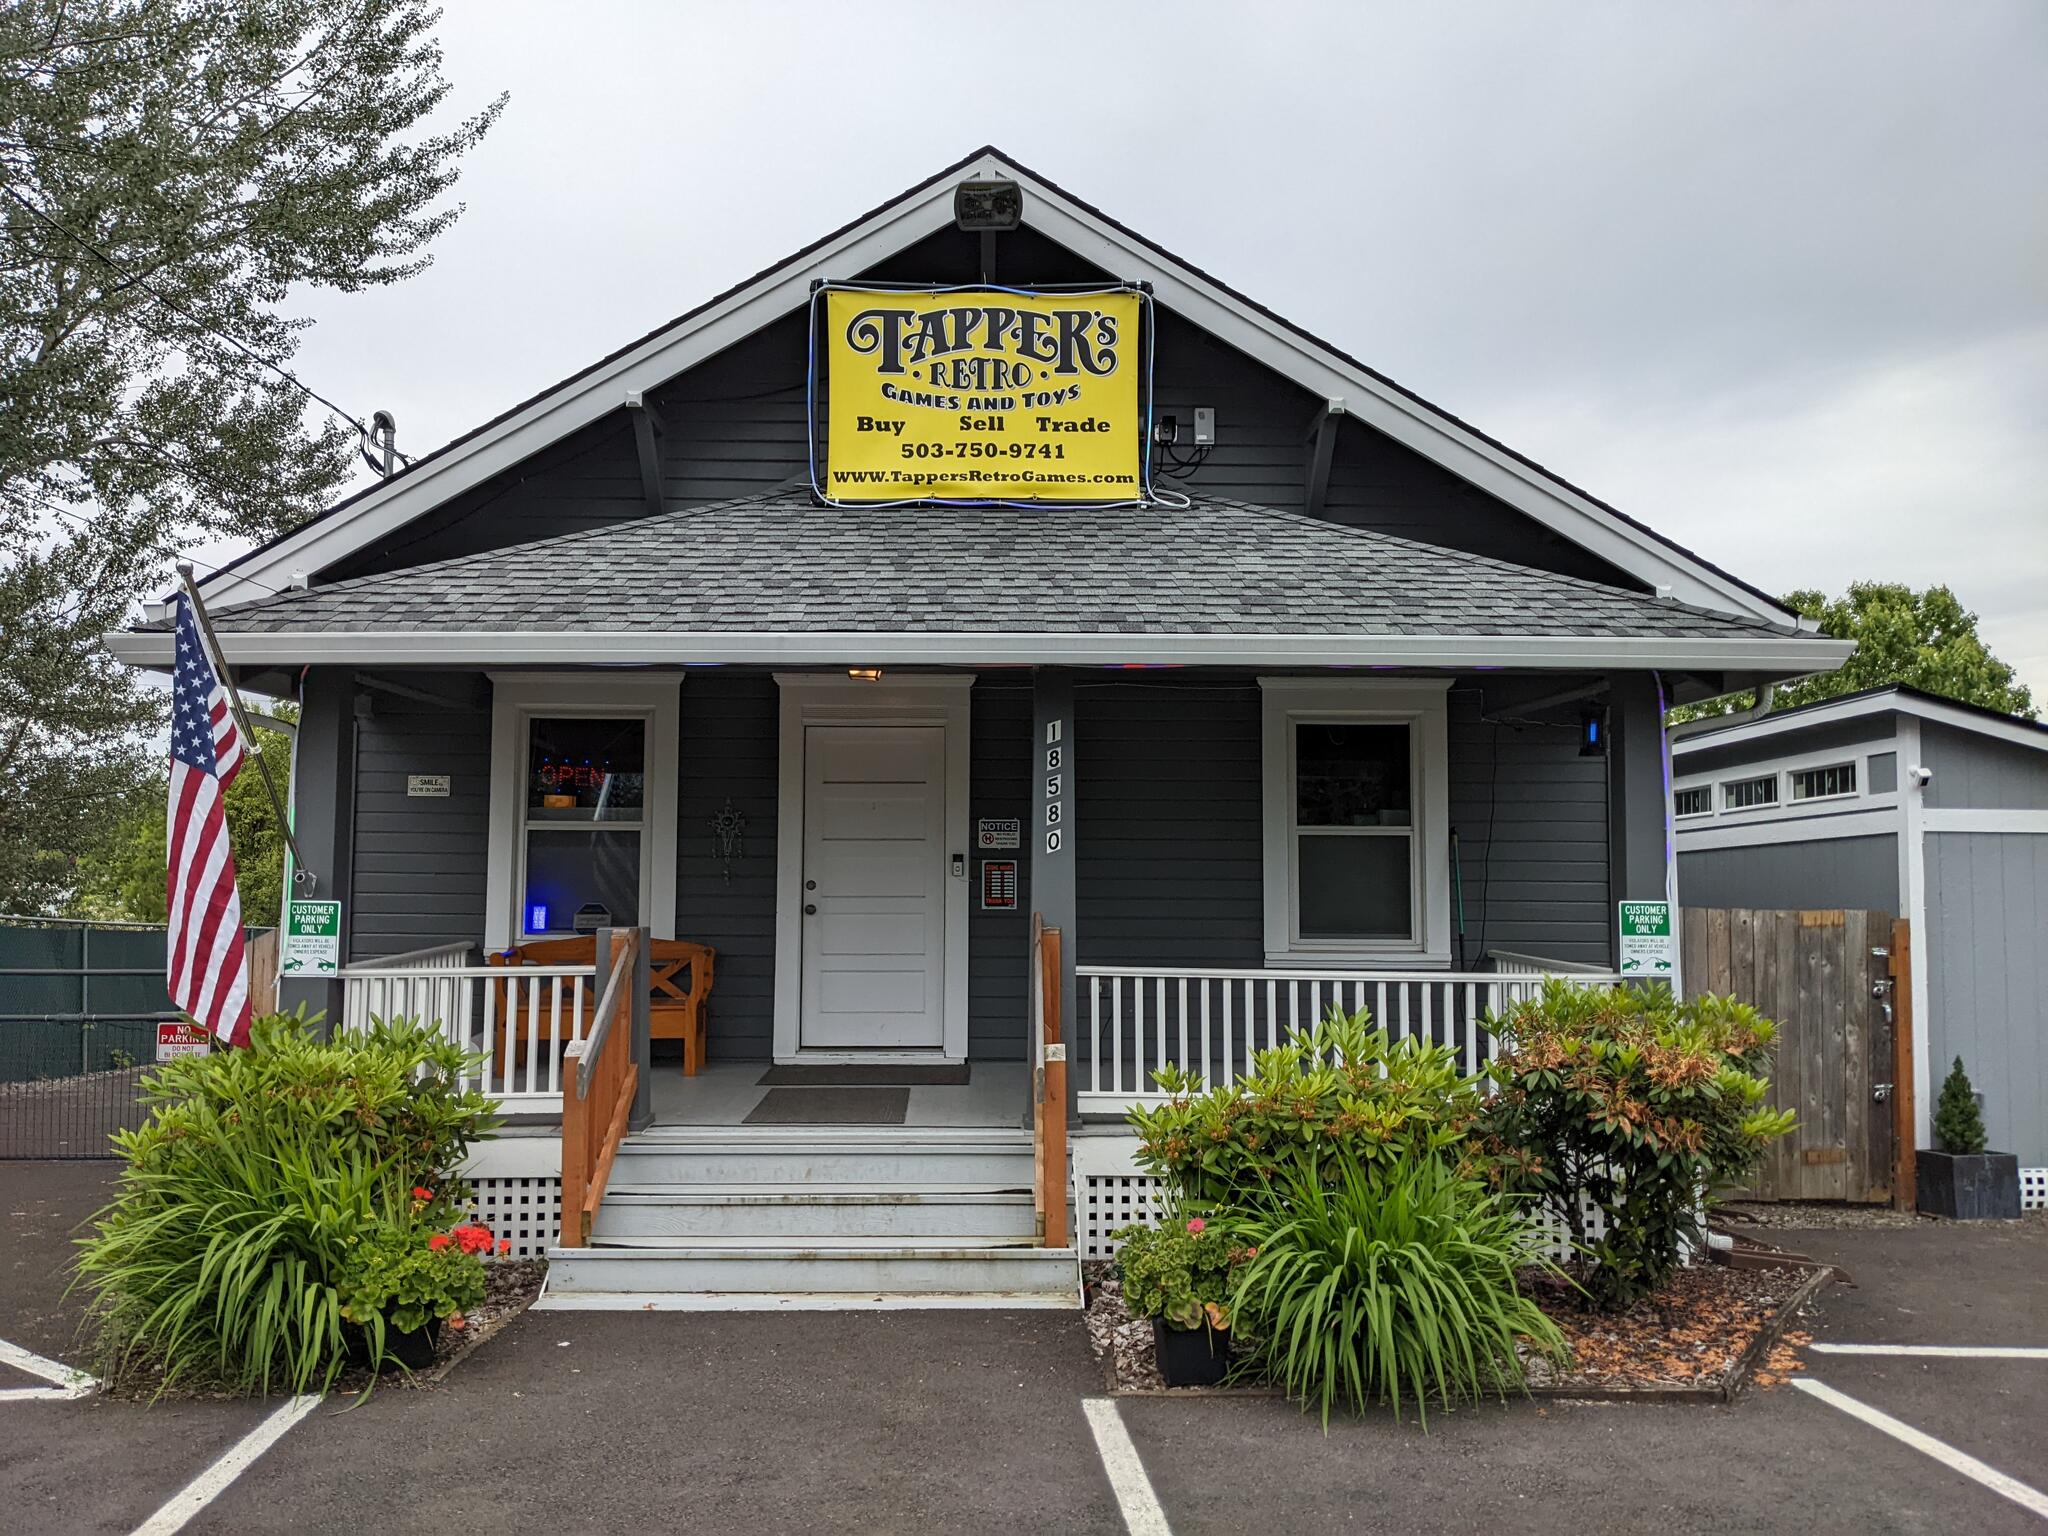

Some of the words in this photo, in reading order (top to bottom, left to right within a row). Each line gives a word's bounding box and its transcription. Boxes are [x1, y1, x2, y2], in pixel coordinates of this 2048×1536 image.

[929, 357, 1032, 390] RETRO
[881, 382, 960, 410] GAMES
[967, 396, 1016, 411] AND
[1022, 383, 1081, 408] TOYS
[856, 415, 906, 436] Buy
[959, 415, 1005, 431] Sell
[1036, 417, 1111, 433] Trade
[901, 443, 1065, 459] 503-750-9741
[541, 765, 605, 787] OPEN
[1047, 723, 1060, 851] 18580
[981, 822, 1017, 831] NOTICE
[291, 905, 335, 915] CUSTOMER
[1624, 905, 1667, 915] CUSTOMER
[294, 914, 330, 925] PARKING
[1629, 914, 1664, 925] PARKING
[300, 924, 323, 934] ONLY
[1635, 924, 1657, 934] ONLY
[176, 1025, 192, 1035] NO
